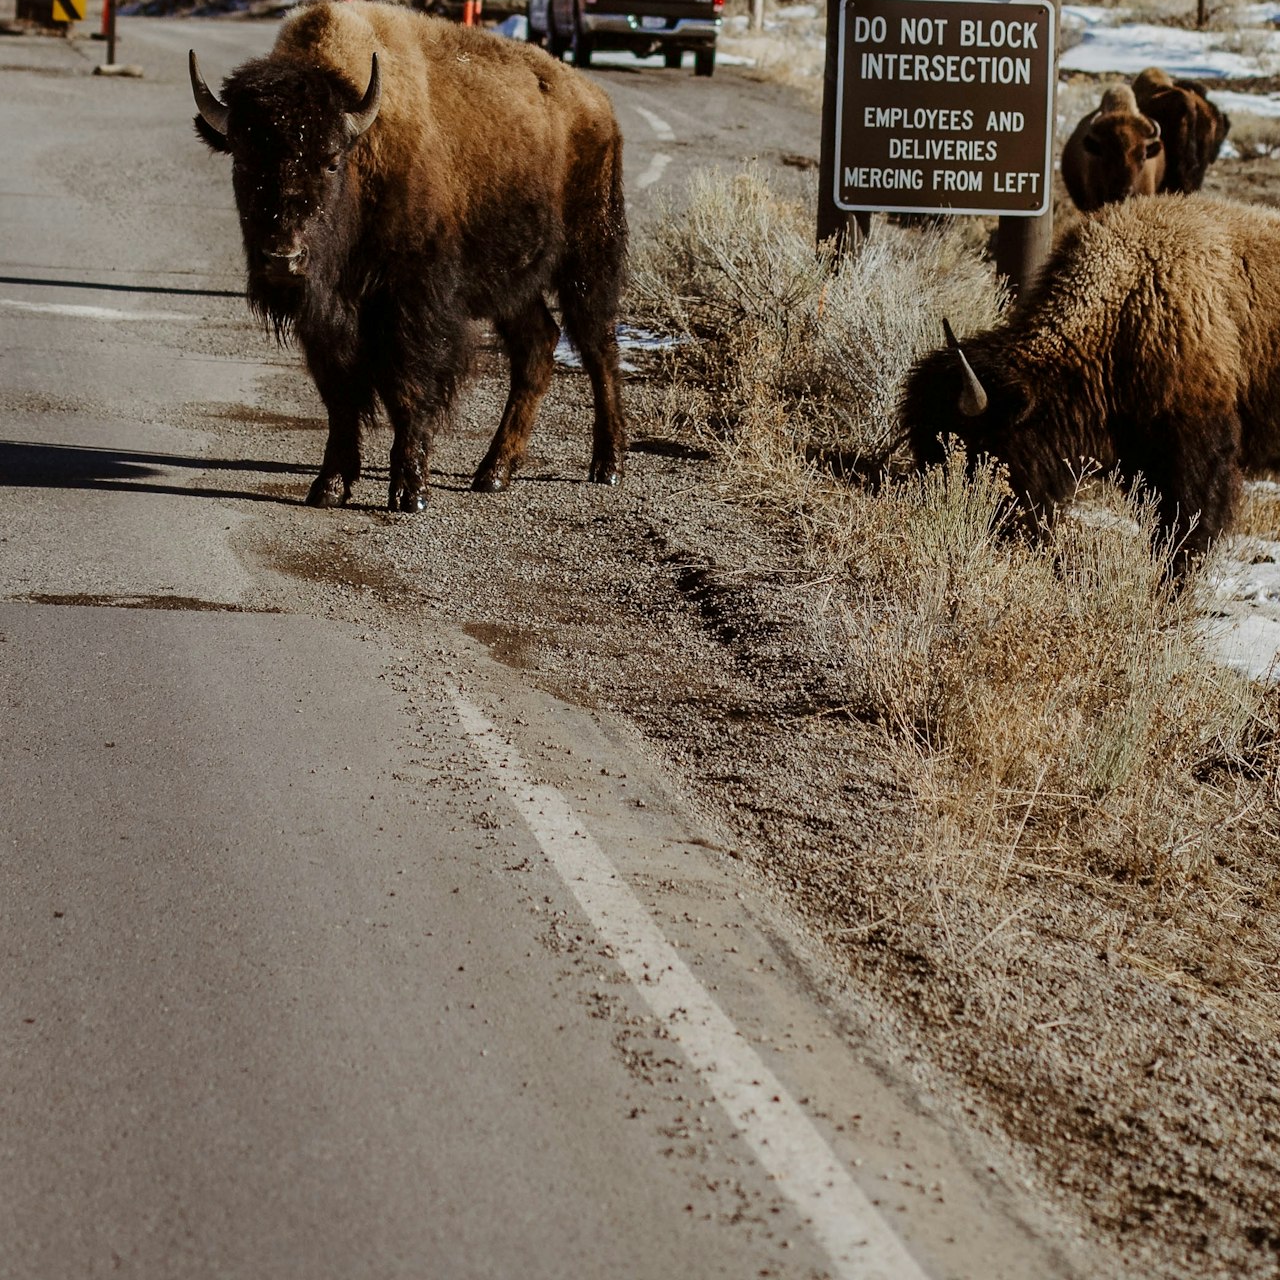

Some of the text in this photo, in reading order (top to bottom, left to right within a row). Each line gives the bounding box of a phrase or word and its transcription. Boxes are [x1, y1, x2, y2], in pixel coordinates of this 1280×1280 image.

[854, 15, 1038, 49] DO NOT BLOCK
[860, 53, 1031, 85] INTERSECTION
[864, 107, 1025, 132] EMPLOYEES AND
[889, 138, 998, 162] DELIVERIES
[844, 166, 1040, 194] MERGING FROM LEFT
